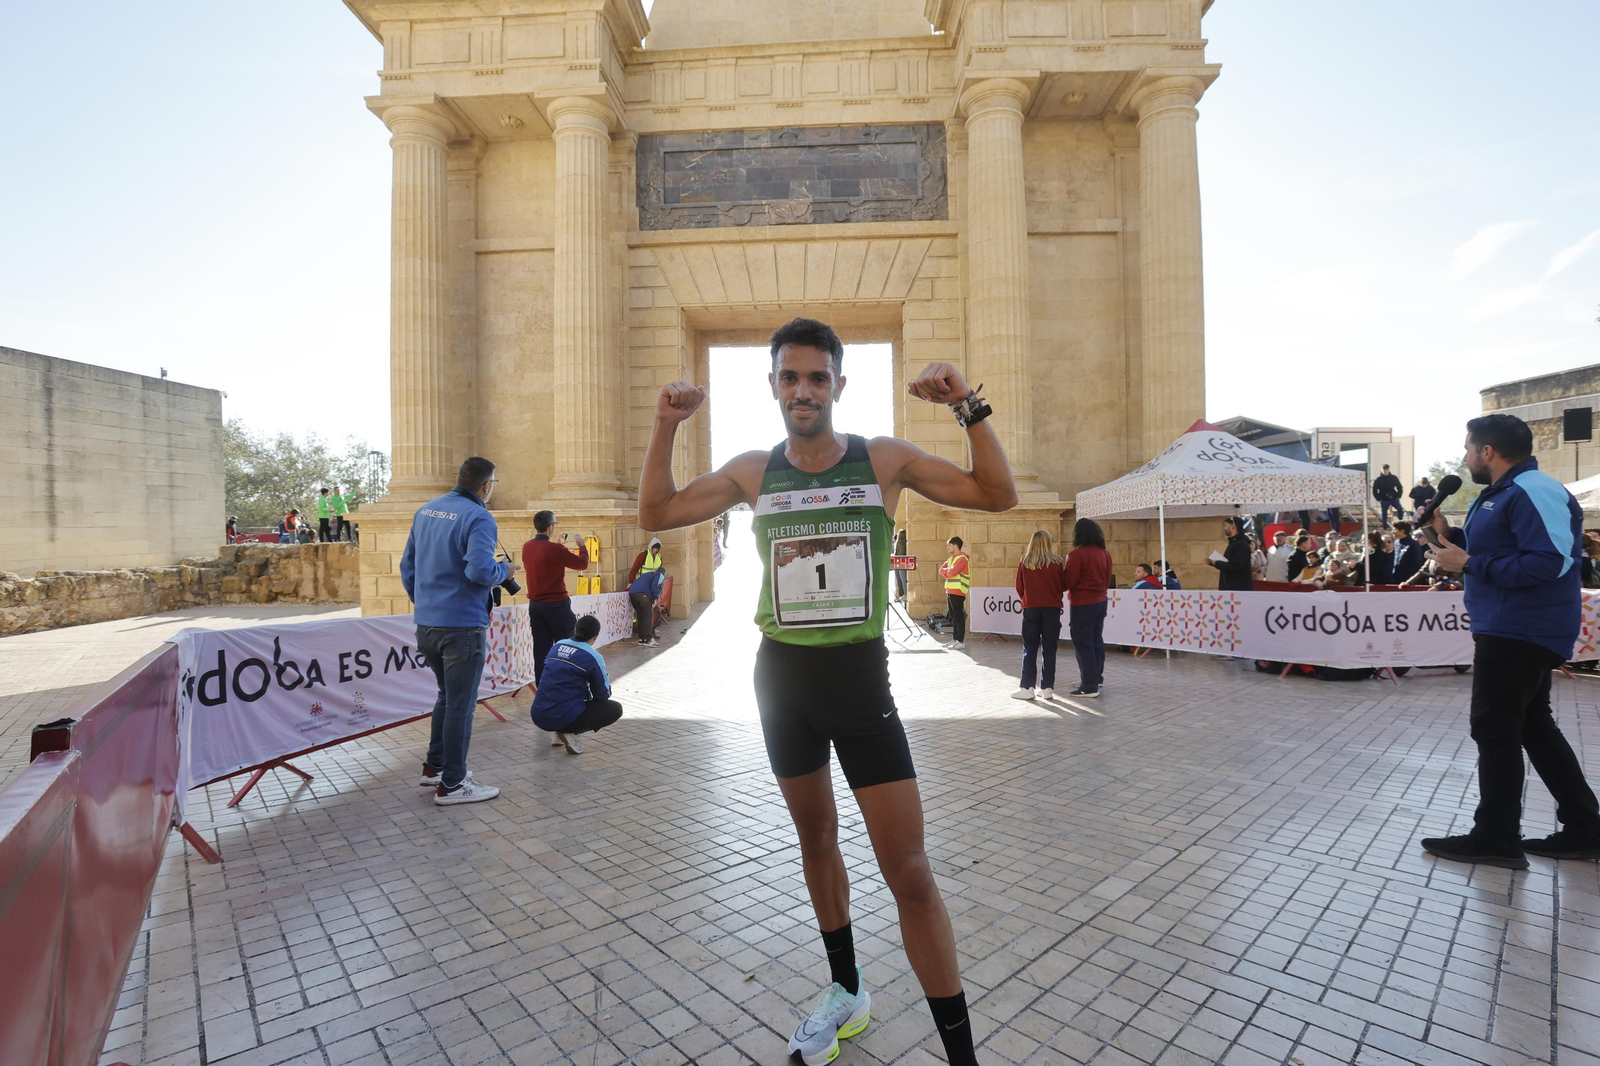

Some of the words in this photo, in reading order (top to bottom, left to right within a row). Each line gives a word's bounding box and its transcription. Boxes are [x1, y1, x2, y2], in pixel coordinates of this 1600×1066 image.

[767, 524, 816, 539] ATLETISMO
[819, 518, 872, 534] CORDOBÉS
[816, 563, 827, 590] 1
[983, 595, 1023, 616] Córdo
[1385, 613, 1409, 633] ES
[557, 644, 578, 655] STAFF
[338, 648, 373, 684] ES
